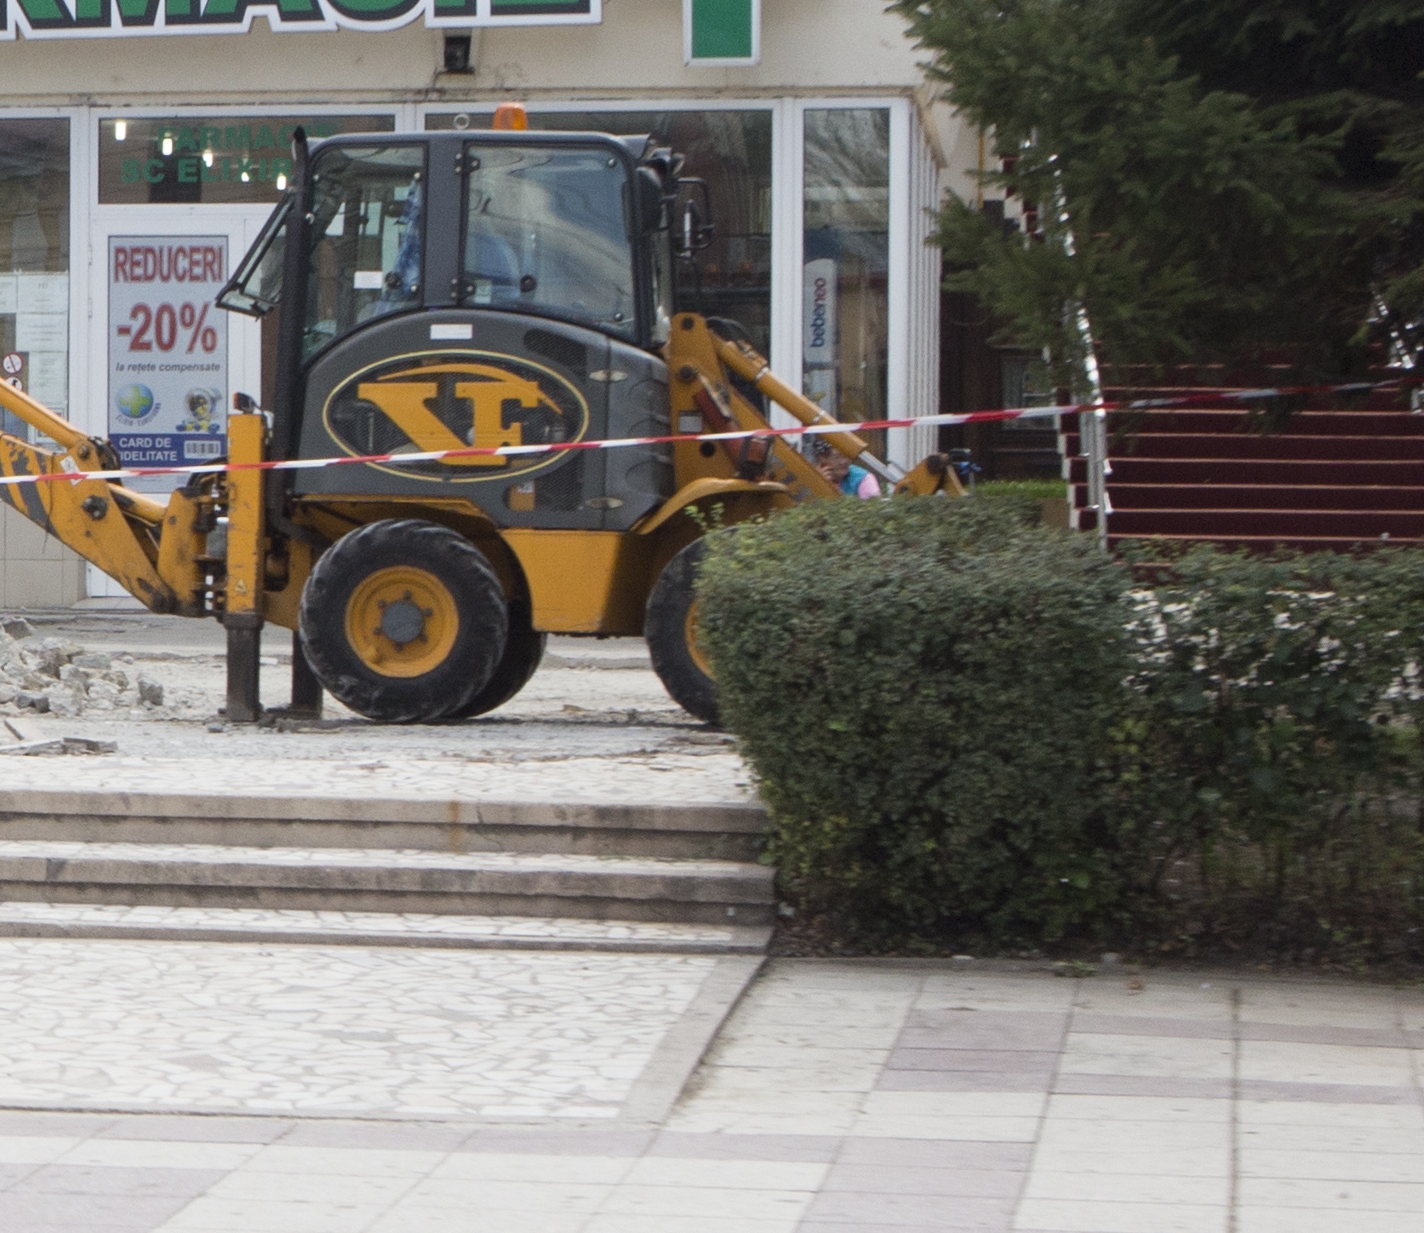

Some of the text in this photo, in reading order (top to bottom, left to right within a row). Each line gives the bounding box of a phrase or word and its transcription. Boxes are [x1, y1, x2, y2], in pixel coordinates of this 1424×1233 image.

[120, 157, 165, 185] SC
[113, 245, 224, 283] REDUCERI
[116, 302, 218, 355] -20%
[159, 362, 221, 374] compensate
[119, 437, 172, 448] CARD DE
[120, 450, 178, 462] IDELITATE
